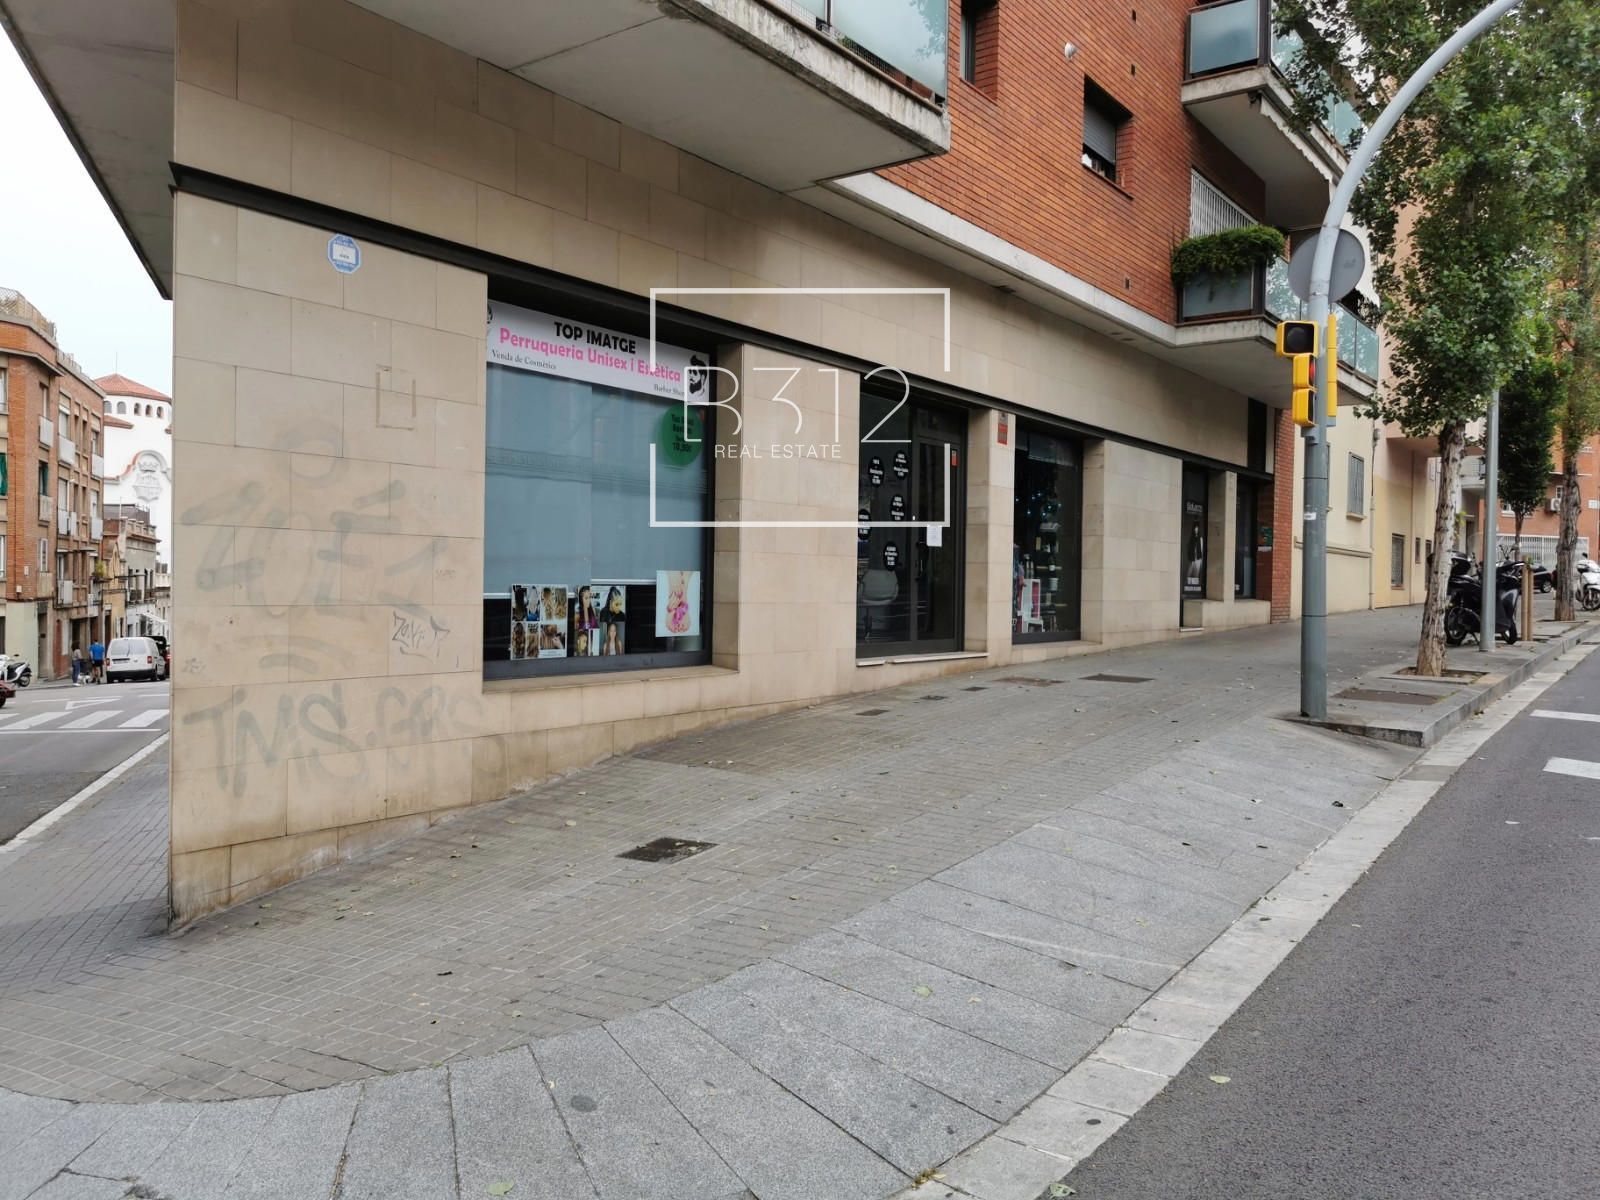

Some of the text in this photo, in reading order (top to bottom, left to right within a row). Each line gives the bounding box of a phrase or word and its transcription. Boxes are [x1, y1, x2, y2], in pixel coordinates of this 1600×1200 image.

[500, 327, 583, 361] Perruqueria
[588, 349, 627, 371] Unisex
[554, 321, 636, 354] TOP IMATGE
[491, 349, 513, 362] Venda
[514, 355, 522, 363] de
